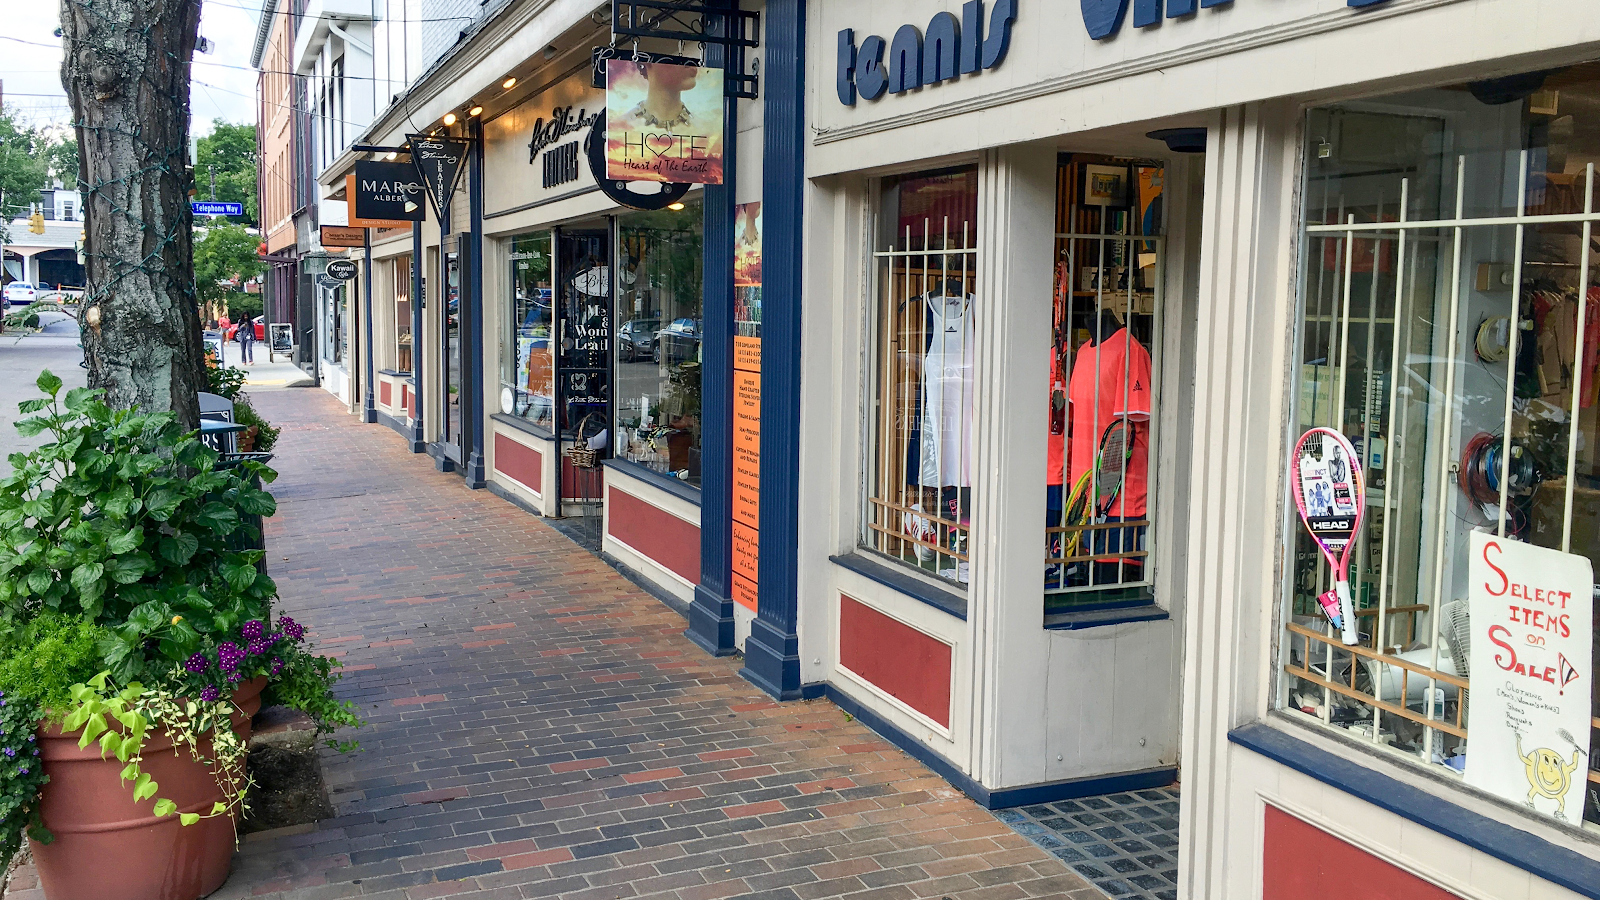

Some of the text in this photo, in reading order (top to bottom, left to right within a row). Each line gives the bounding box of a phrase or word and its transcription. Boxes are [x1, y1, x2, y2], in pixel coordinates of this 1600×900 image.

[837, 0, 1018, 107] tennis
[624, 158, 708, 177] Heart of The Earth
[362, 180, 419, 195] MARC
[374, 195, 406, 203] ALBER
[196, 204, 239, 215] Telephone Way
[331, 264, 355, 272] Kawaii
[1313, 521, 1349, 530] HEAD
[1484, 541, 1572, 609] SELECT
[1510, 605, 1571, 638] ITEMS
[1526, 634, 1546, 646] on
[1505, 680, 1543, 701] CLOTHING
[1507, 702, 1525, 715] Shoes
